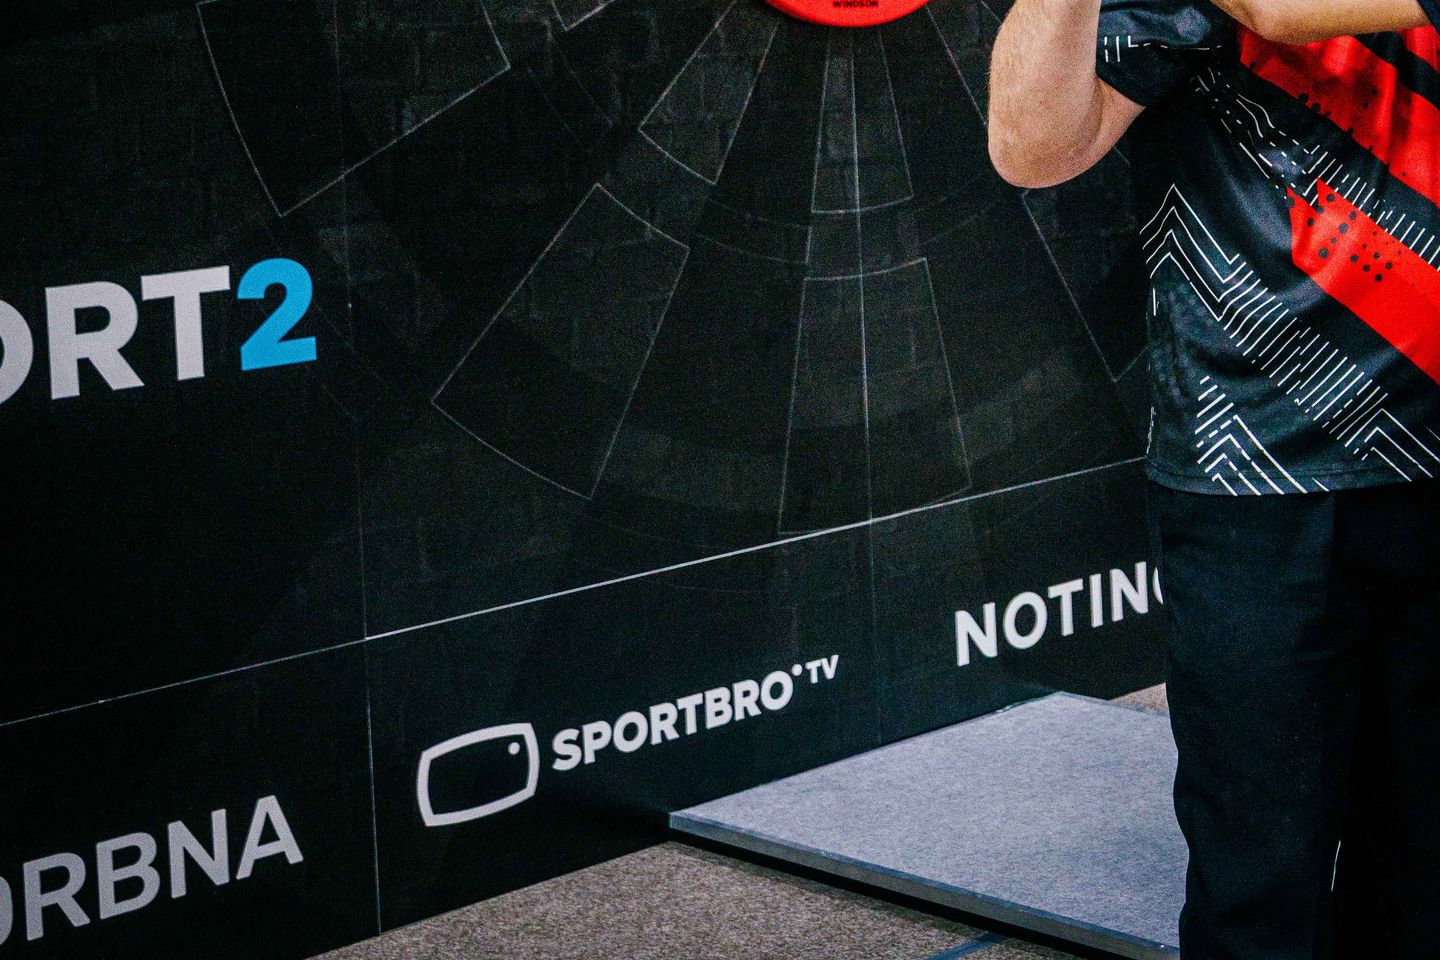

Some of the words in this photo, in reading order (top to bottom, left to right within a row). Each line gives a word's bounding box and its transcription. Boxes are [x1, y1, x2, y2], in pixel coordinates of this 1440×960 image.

[551, 668, 794, 772] SPORTBRO
[807, 653, 841, 686] TV
[0, 794, 304, 946] RBNA
